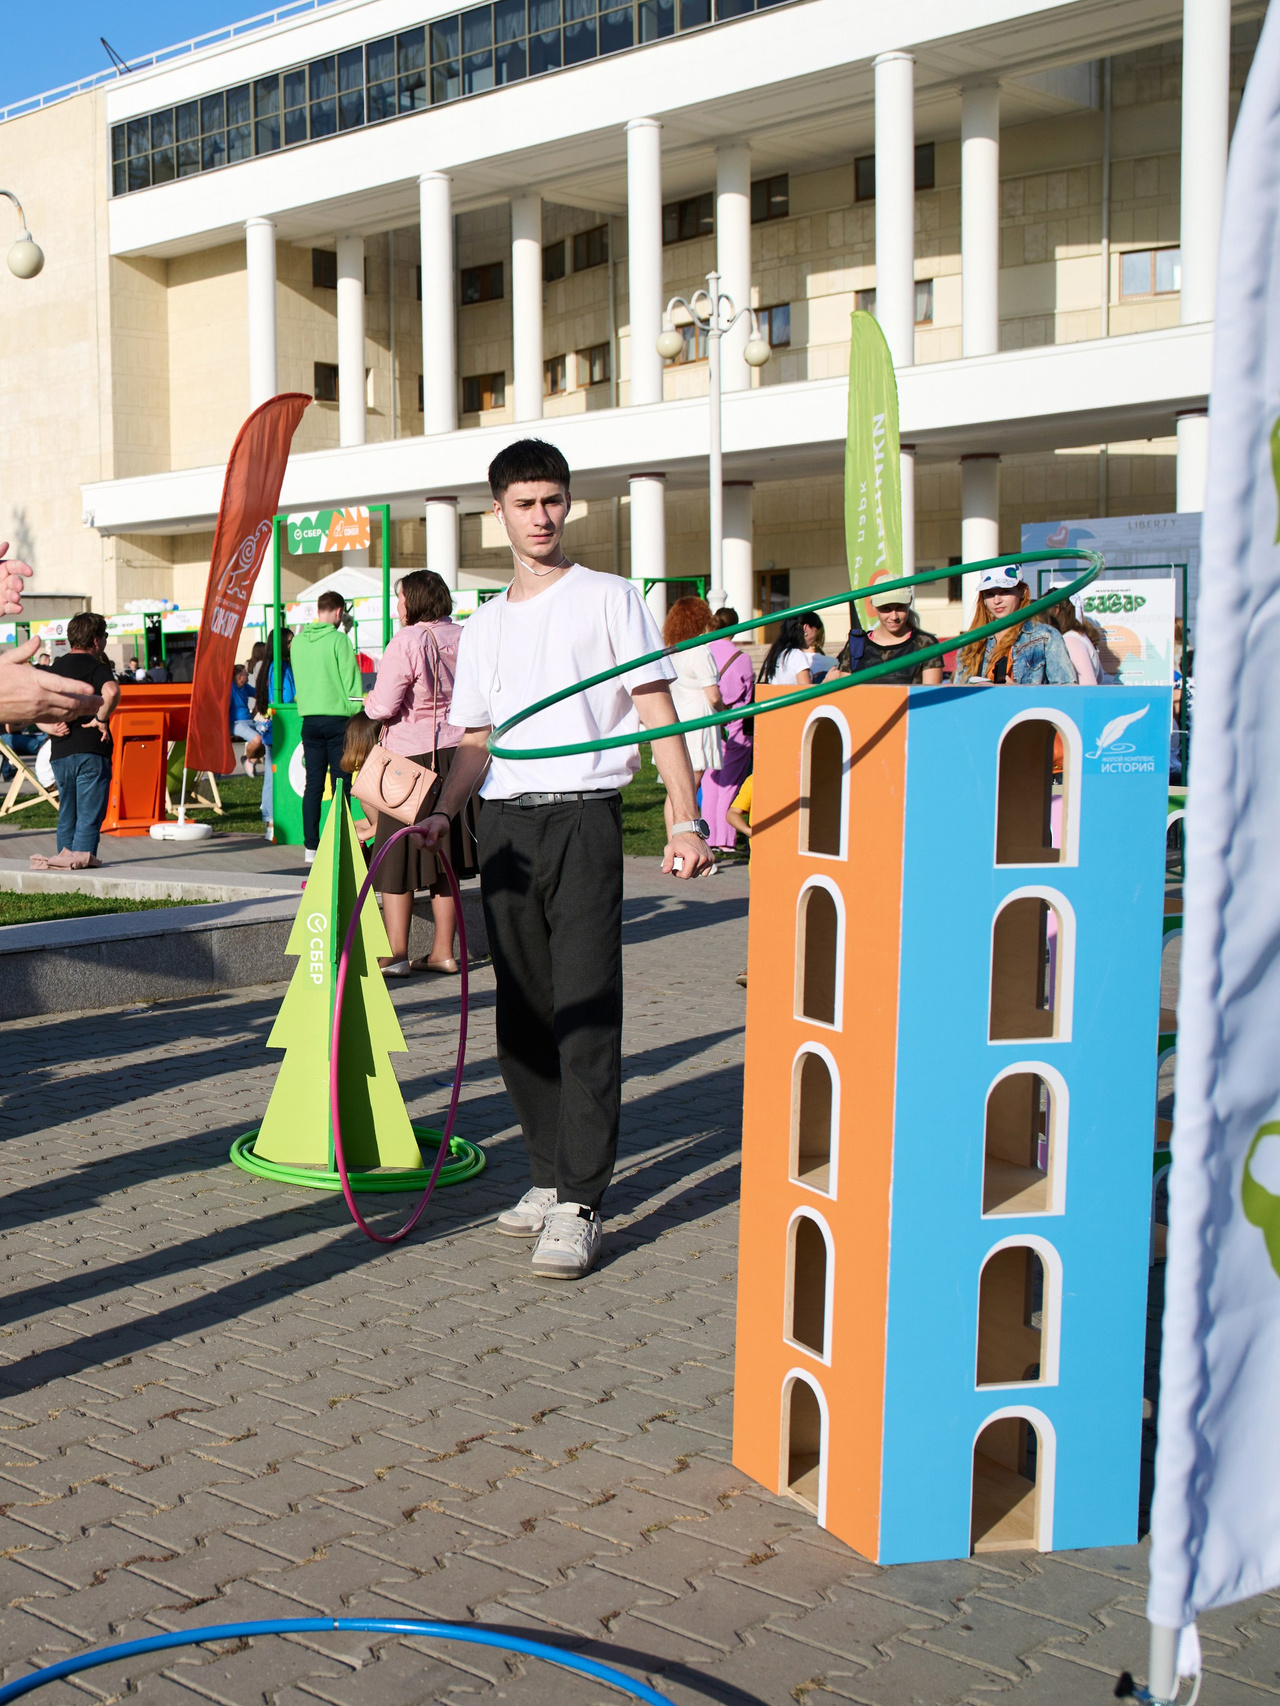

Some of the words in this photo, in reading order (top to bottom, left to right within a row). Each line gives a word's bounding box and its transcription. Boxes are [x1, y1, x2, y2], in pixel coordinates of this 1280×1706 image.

[1127, 518, 1177, 530] LIBERTY
[303, 528, 322, 538] СБЕР
[1101, 762, 1155, 773] ИСТОРИЯ
[310, 937, 324, 985] СБЕР
